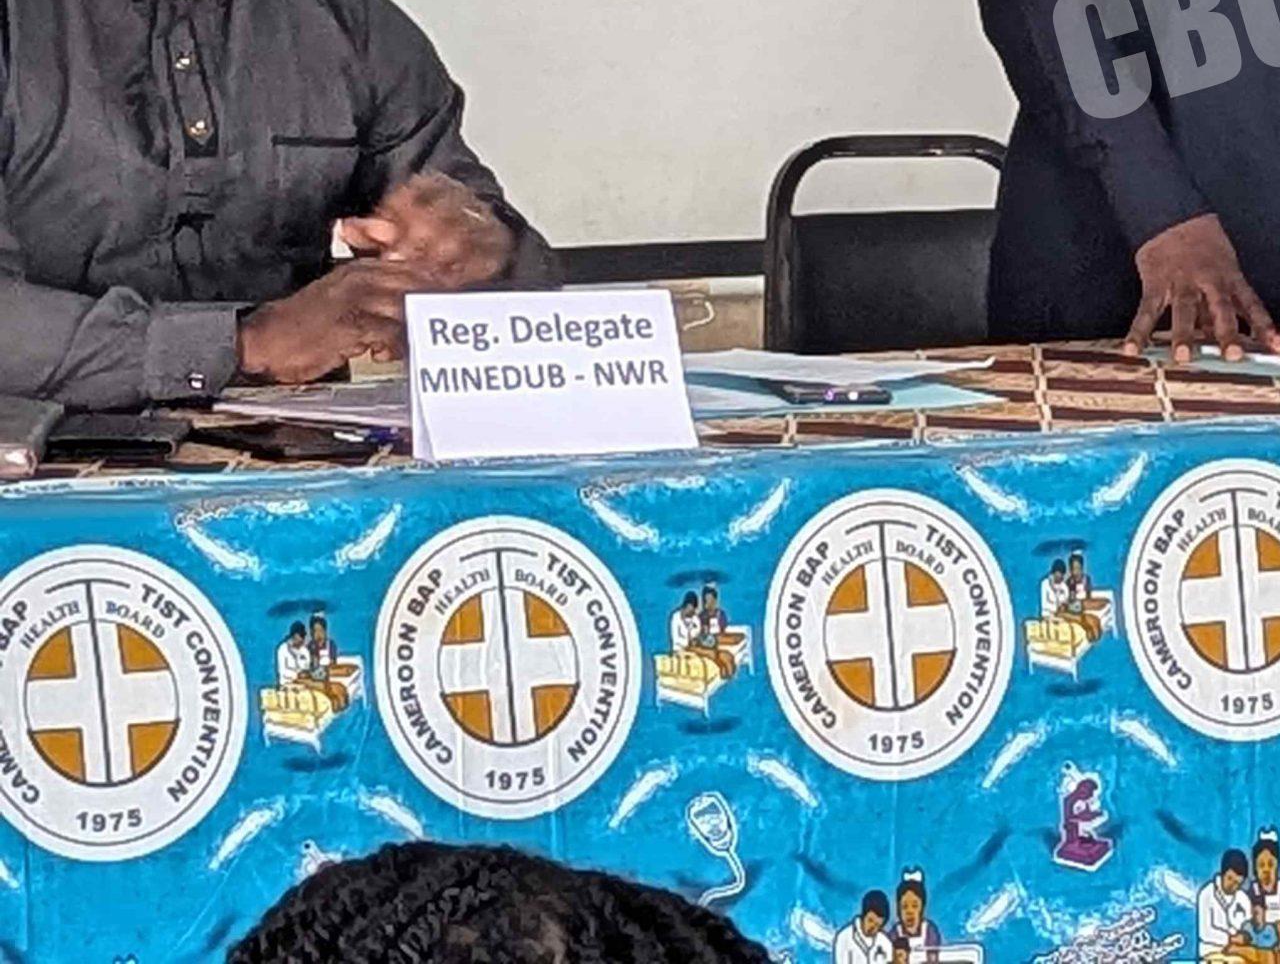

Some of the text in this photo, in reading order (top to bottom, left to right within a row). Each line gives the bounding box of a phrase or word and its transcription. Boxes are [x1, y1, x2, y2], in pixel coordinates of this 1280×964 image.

[428, 312, 654, 352] Reg. Delegate
[419, 364, 566, 394] MINEDUB
[593, 359, 669, 387] NWR
[1153, 508, 1186, 555] BAP
[1177, 508, 1227, 552] HEALTH
[822, 540, 945, 587] HEALTH BOARD
[435, 569, 568, 615] HEALTH BOARD
[20, 600, 166, 649] HEALTH BOARD
[786, 524, 991, 729] CAMEROON BAP TIST CONVENTION
[1144, 559, 1193, 690] CAMEROON
[397, 553, 617, 765] CAMEROON BAP TIST CONVENTION
[141, 584, 190, 630] TIST
[167, 630, 222, 803] CONVENTION
[1221, 693, 1273, 714] 1975
[868, 731, 924, 754] 1975
[485, 767, 545, 790] 1975
[76, 809, 143, 832] 1975
